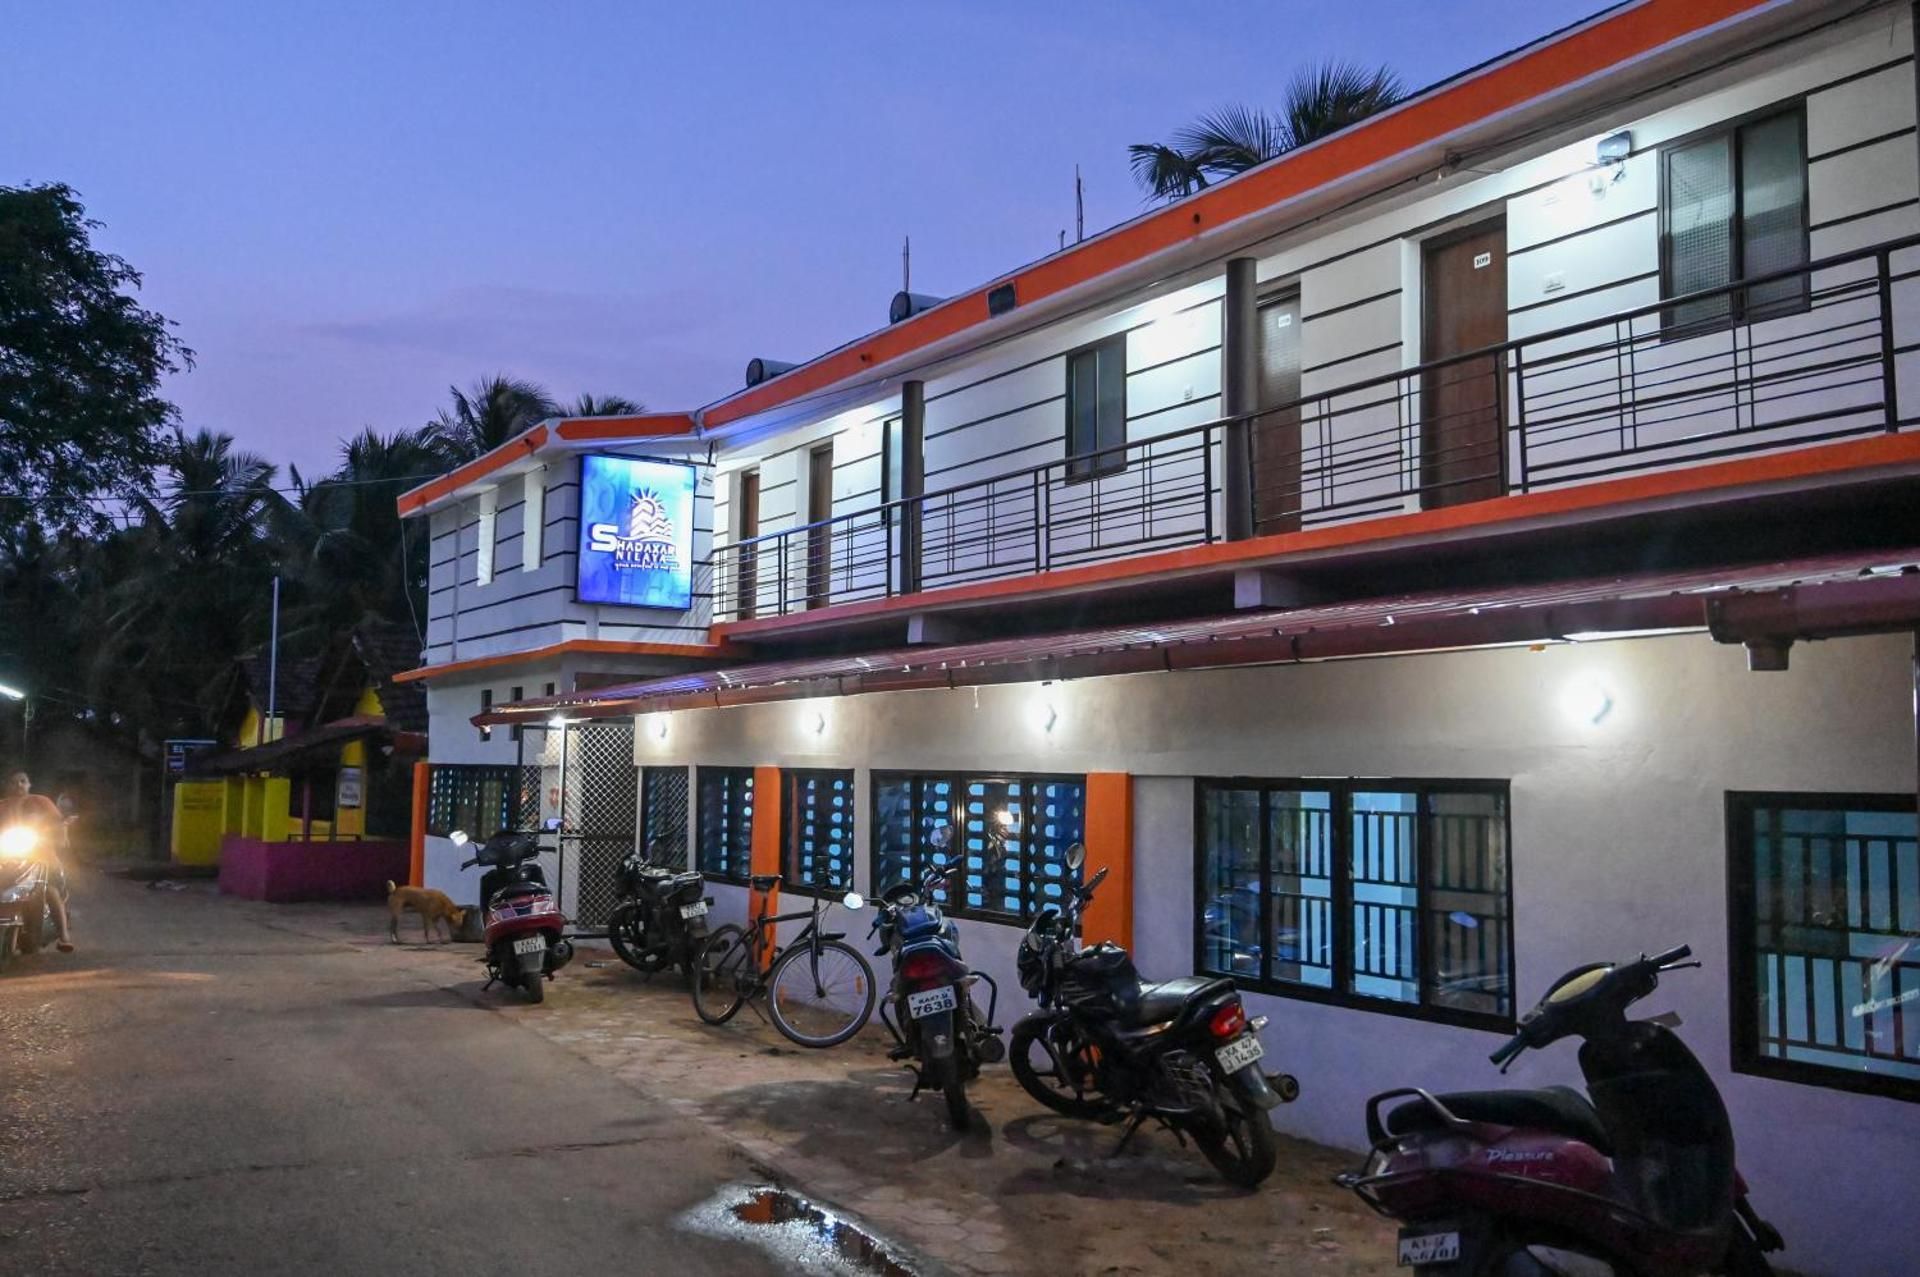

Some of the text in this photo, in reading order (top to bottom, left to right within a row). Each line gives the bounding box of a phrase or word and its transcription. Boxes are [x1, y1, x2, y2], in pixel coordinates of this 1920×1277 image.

[616, 551, 666, 562] NILAYA
[913, 999, 952, 1016] 7638
[1226, 1039, 1251, 1057] KA 47
[1487, 1147, 1553, 1162] Pleasure
